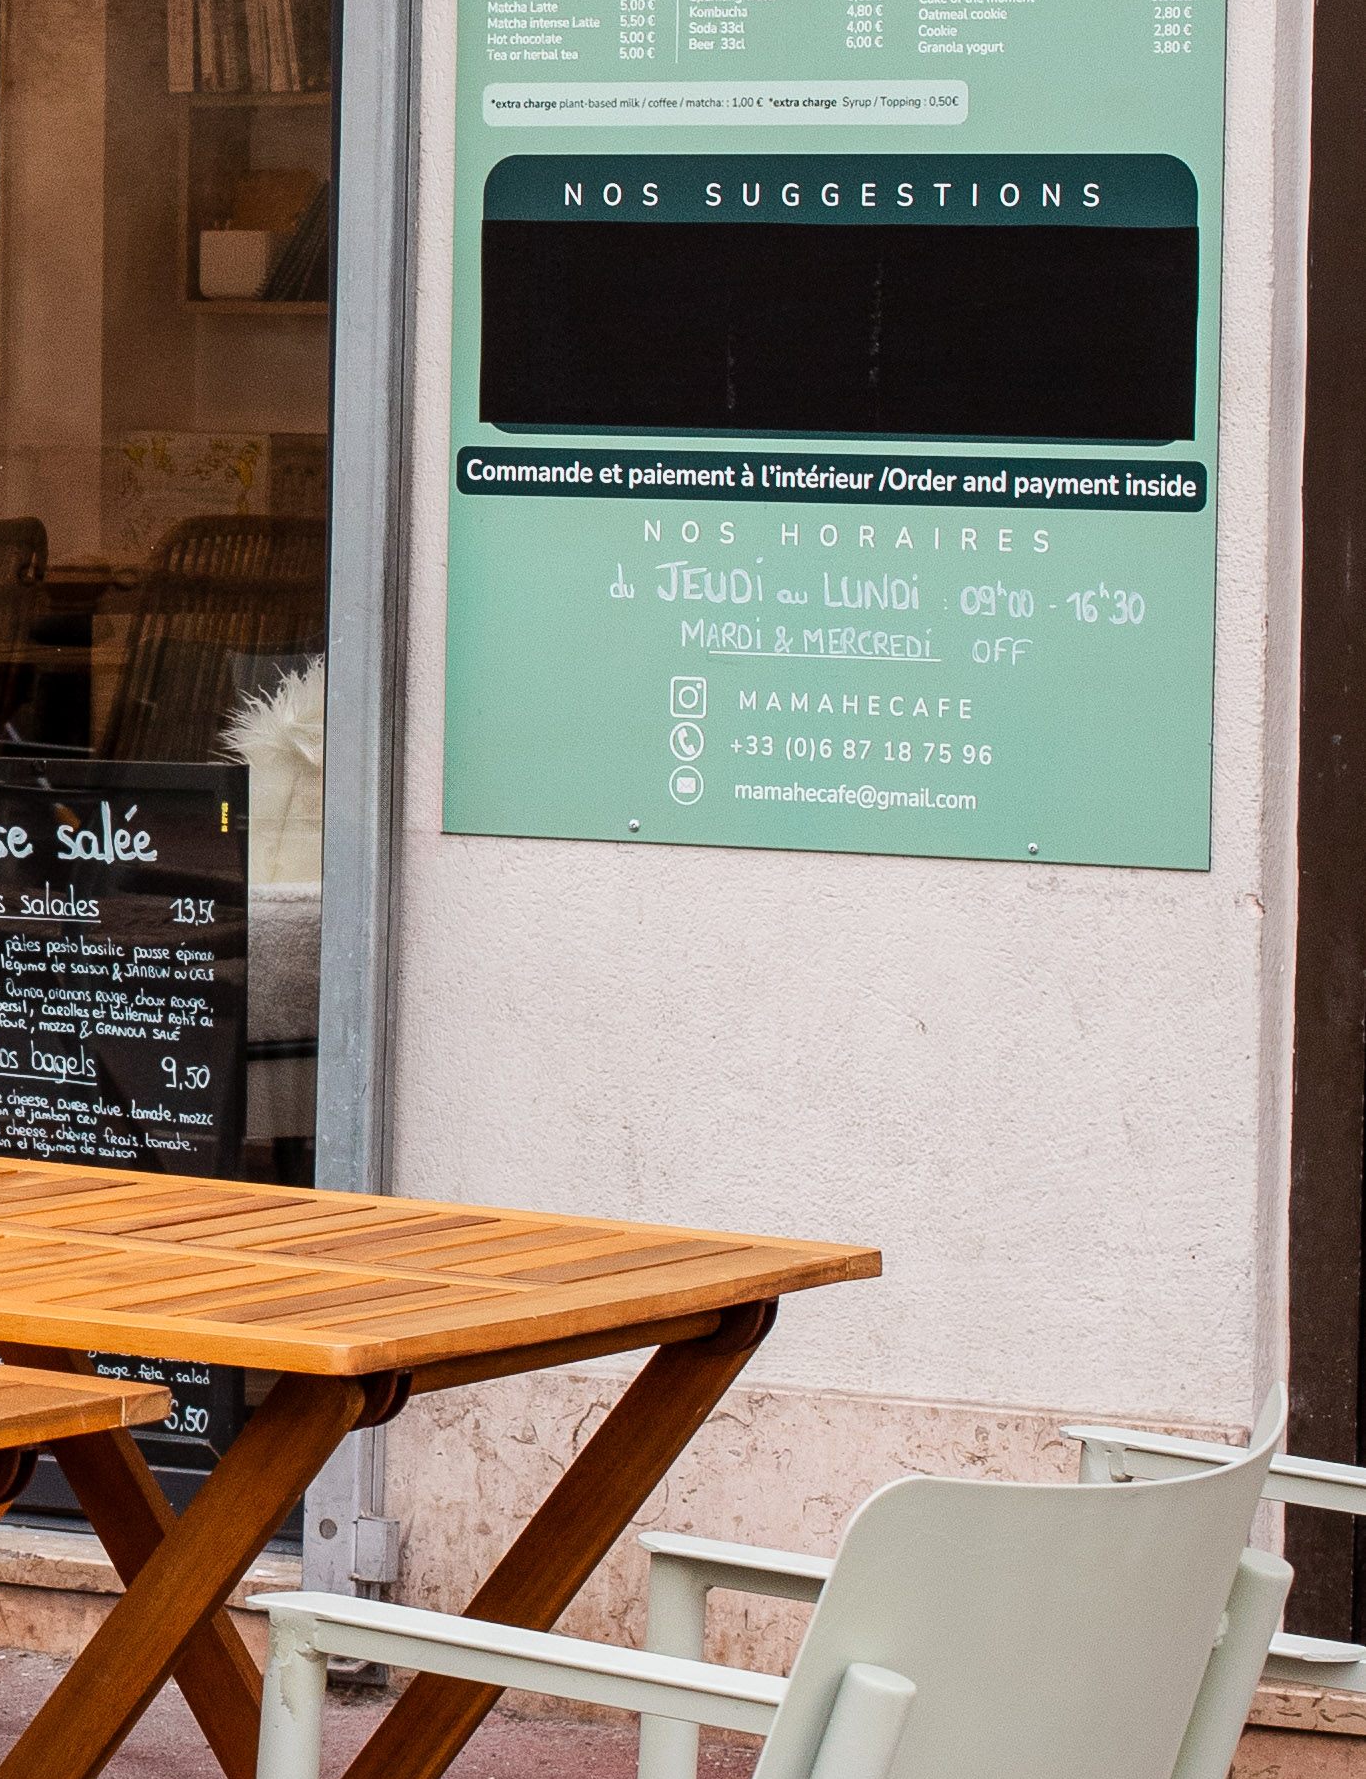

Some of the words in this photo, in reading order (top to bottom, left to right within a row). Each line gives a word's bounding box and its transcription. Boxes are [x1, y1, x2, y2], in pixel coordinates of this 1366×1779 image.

[688, 5, 749, 18] Kombucha
[918, 7, 968, 21] Oatmeal
[970, 8, 1008, 20] cookie
[487, 33, 508, 45] Hot
[509, 33, 563, 45] chocolate
[688, 38, 715, 50] Beer
[720, 38, 746, 50] 33cl
[918, 41, 964, 53] Granola
[966, 42, 1005, 55] yogurt
[562, 180, 660, 208] NOS
[704, 180, 1104, 210] SUGGESTIONS
[464, 457, 595, 485] Commande
[597, 461, 623, 485] et
[626, 461, 737, 491] paiement
[739, 459, 757, 488] à
[759, 461, 875, 491] l'intérieur
[961, 467, 1009, 495] and
[1012, 471, 1121, 500] payment
[1123, 472, 1198, 500] inside
[642, 518, 737, 545] NOS
[779, 522, 1052, 555] HORAIRES
[608, 562, 637, 602] du
[775, 586, 810, 608] au
[773, 626, 795, 654] &
[970, 637, 1035, 666] OFF
[737, 689, 975, 722] MAMAHECAFE
[729, 734, 776, 759] +33
[783, 735, 834, 763] (0)6
[840, 738, 874, 761] 87
[881, 740, 914, 764] 18
[921, 741, 954, 766] 75
[960, 743, 994, 767] 96
[732, 777, 978, 813] mamahecafe@gmail.com
[56, 800, 158, 865] salée
[19, 881, 100, 918] salades
[30, 1039, 97, 1084] bagels
[161, 1056, 211, 1090] 9,50
